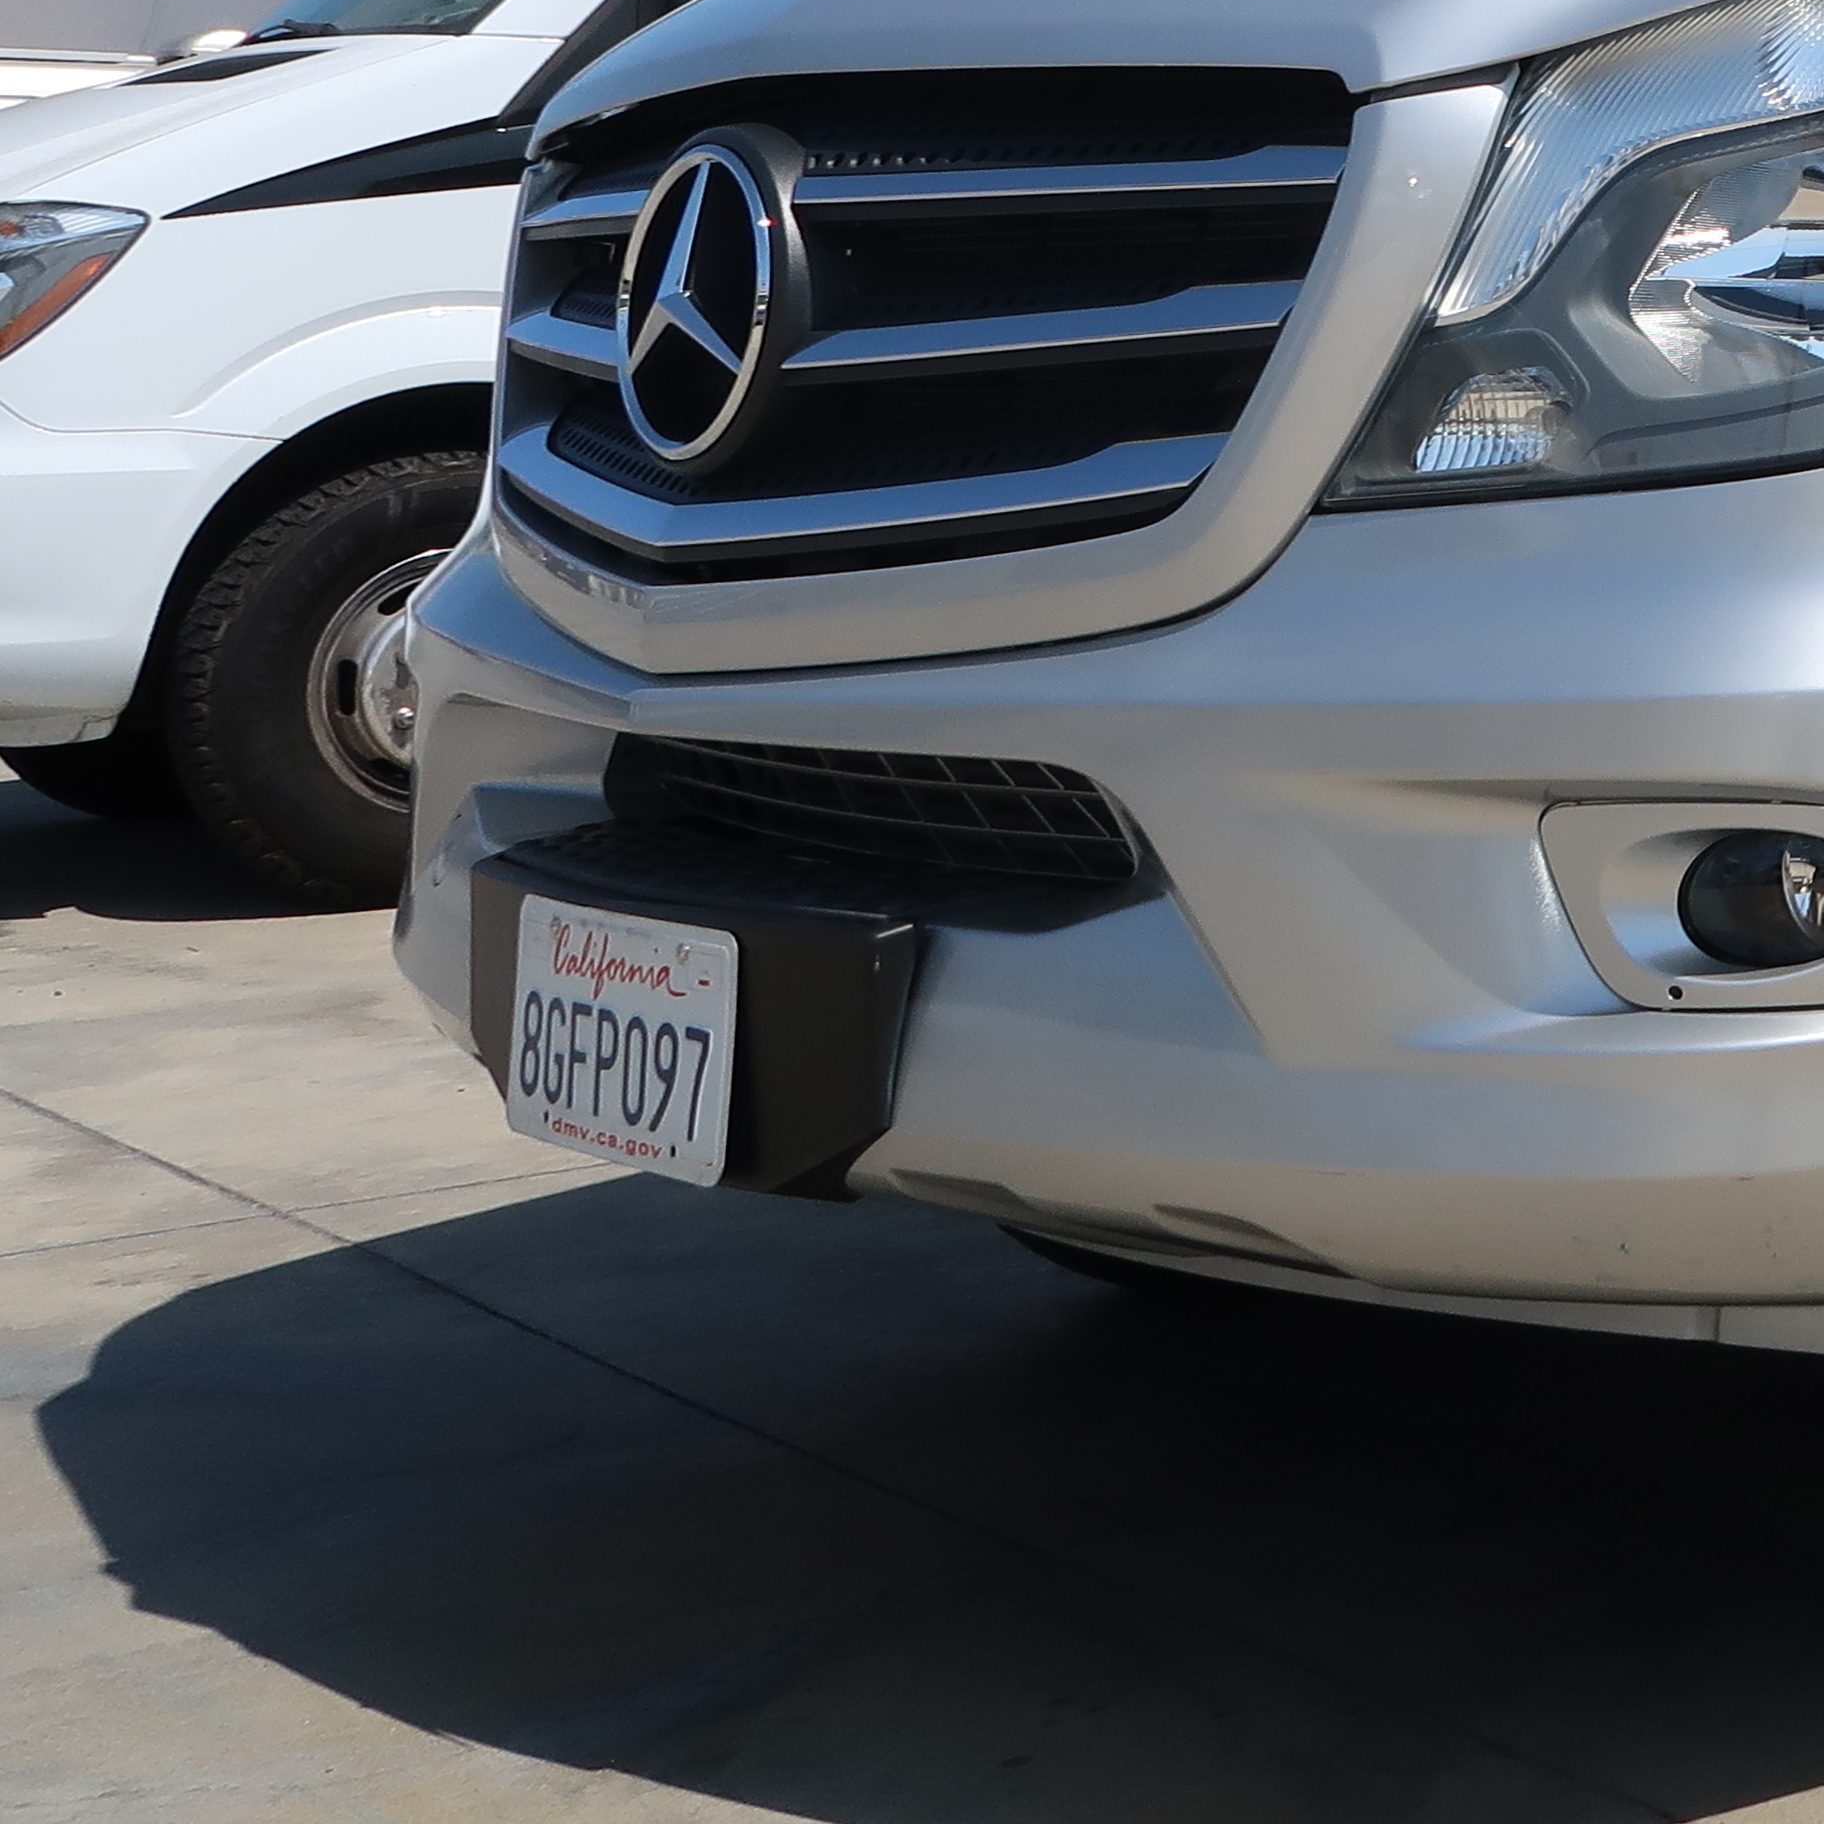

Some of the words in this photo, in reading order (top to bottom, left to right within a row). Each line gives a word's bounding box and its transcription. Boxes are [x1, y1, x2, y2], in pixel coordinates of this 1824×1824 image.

[552, 923, 688, 1000] California
[519, 990, 712, 1142] 8GFP097
[551, 1117, 662, 1158] dmv.ca.gov
